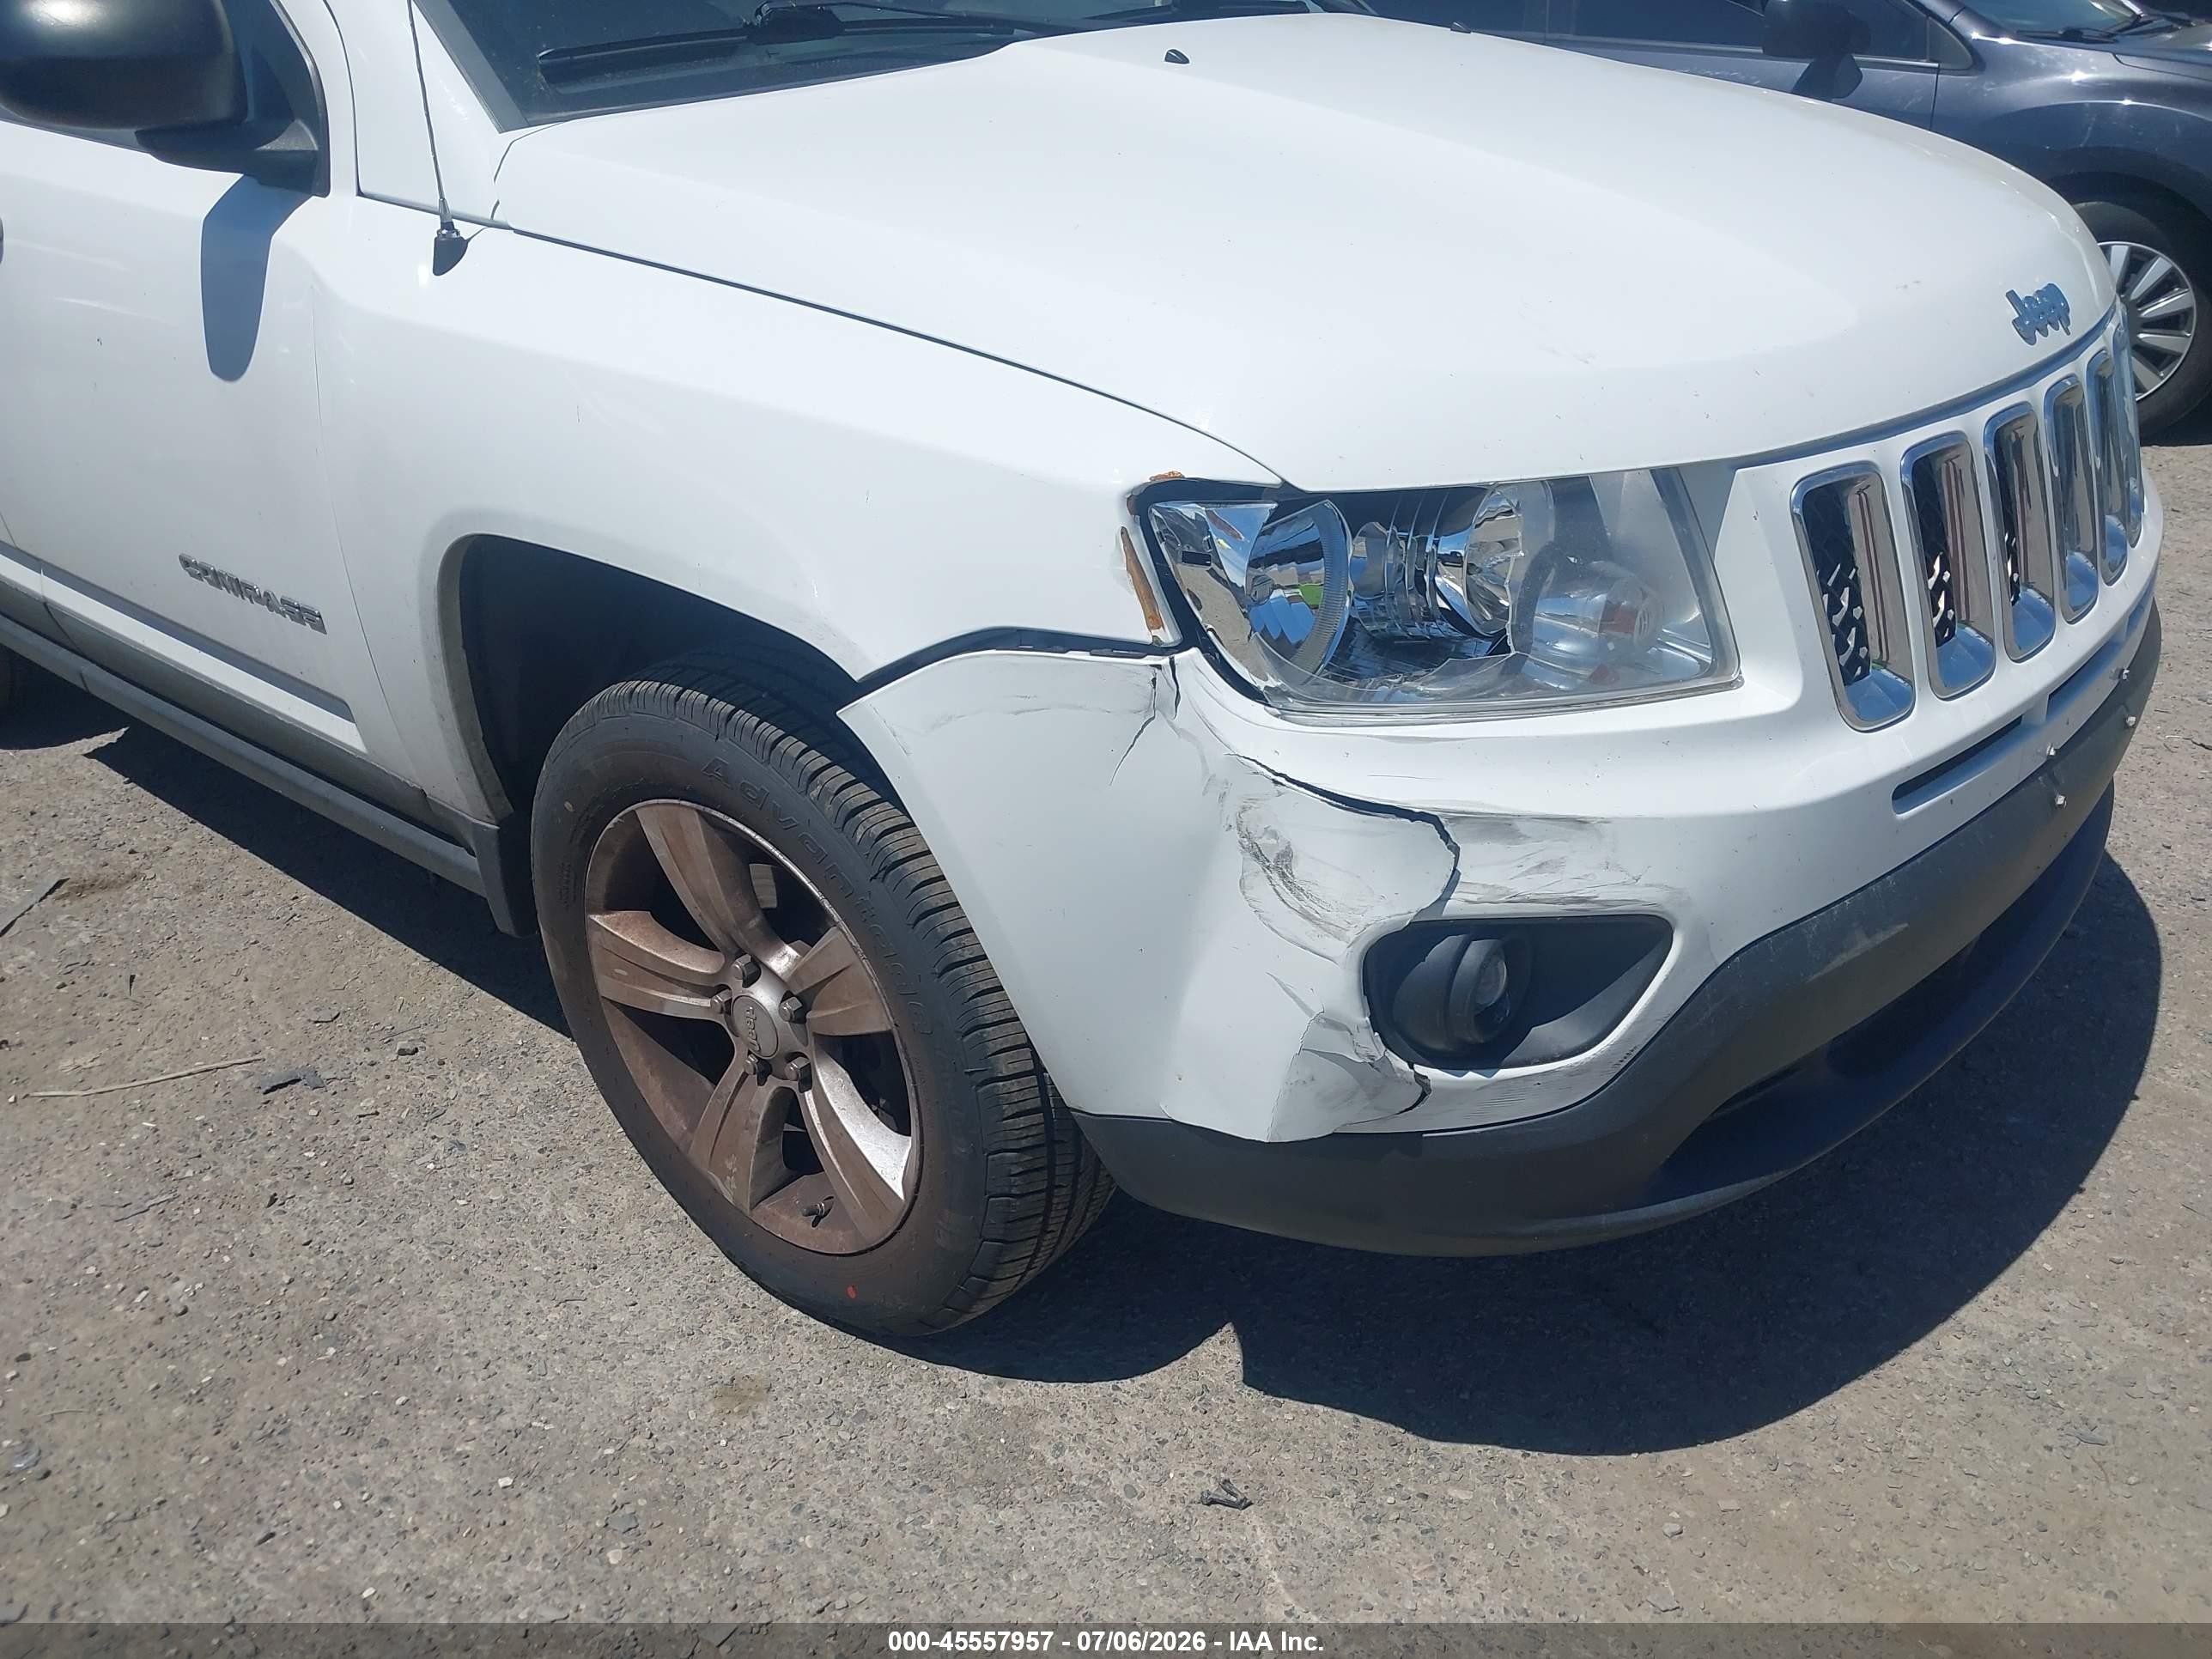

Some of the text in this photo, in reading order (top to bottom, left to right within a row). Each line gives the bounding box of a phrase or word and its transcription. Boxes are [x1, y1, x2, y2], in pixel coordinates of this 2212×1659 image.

[2005, 283, 2071, 346] Jeep
[179, 553, 327, 635] COMPASS
[745, 1005, 762, 1053] Jeep
